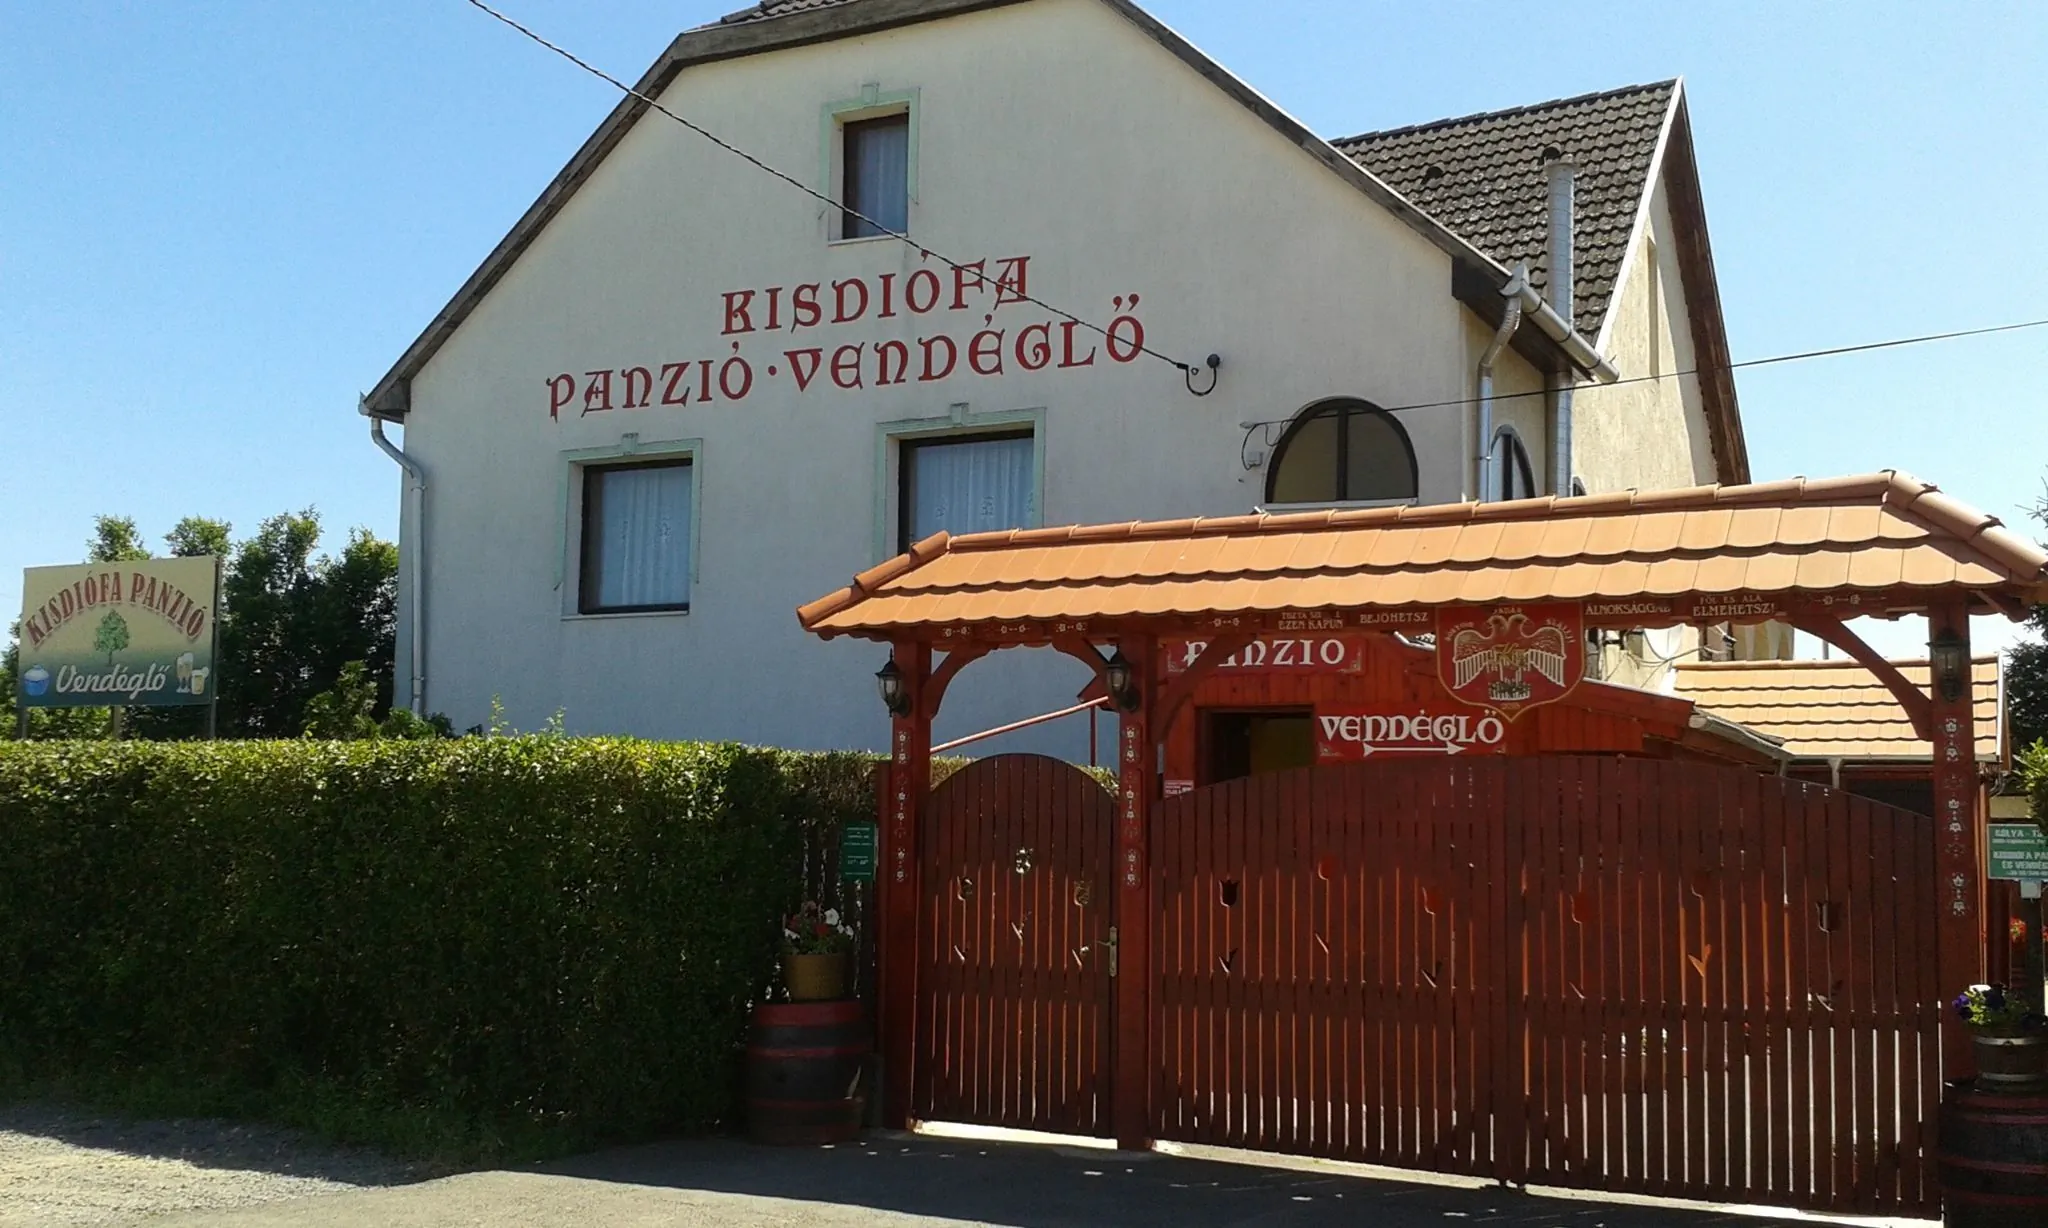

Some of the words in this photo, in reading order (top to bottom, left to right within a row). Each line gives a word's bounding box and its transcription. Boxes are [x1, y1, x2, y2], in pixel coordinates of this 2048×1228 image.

[720, 249, 1031, 335] KISDIÓFA
[546, 341, 753, 422] PANZIÓ
[784, 294, 1145, 392] VENDÉGLŐ
[25, 571, 122, 645] KISDIÓFA
[130, 572, 208, 638] PANZIÓ
[1693, 603, 1775, 617] ELMEHETSZ!
[56, 662, 171, 700] Vendéglő
